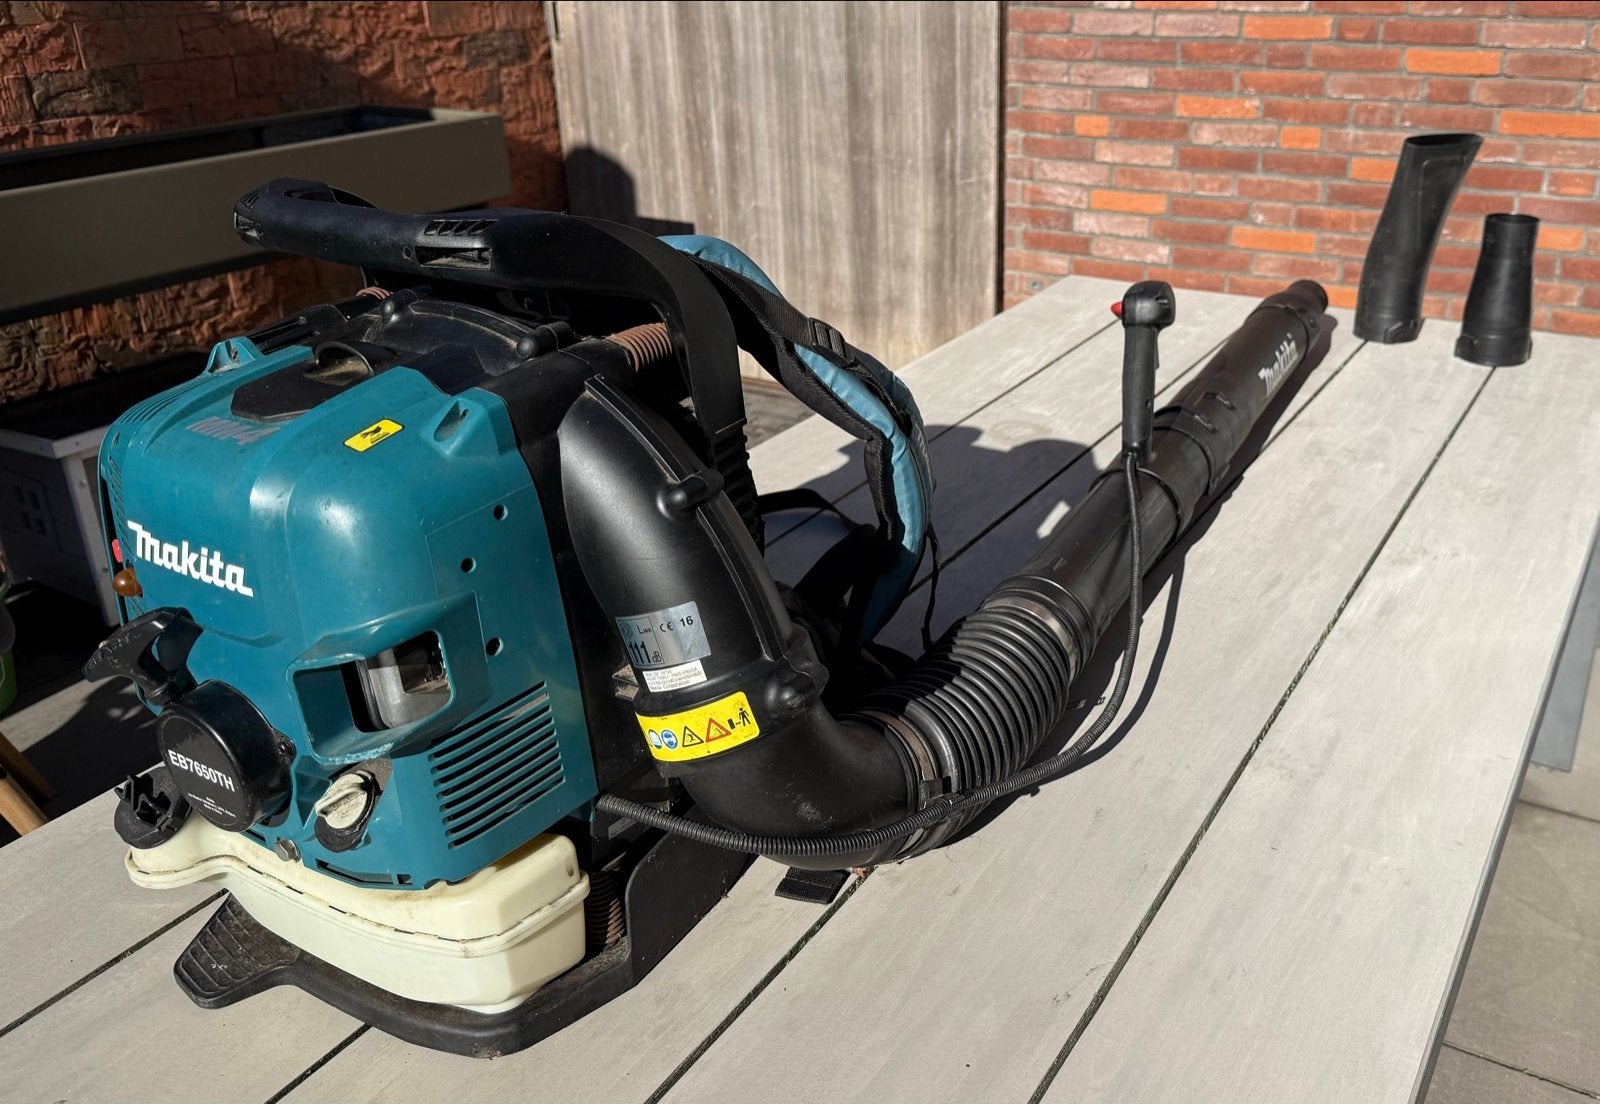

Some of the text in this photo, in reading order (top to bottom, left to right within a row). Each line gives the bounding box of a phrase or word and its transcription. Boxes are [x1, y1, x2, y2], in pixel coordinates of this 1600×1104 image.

[127, 520, 253, 597] Makita
[659, 615, 694, 633] CE 16
[629, 641, 651, 664] 111
[168, 749, 235, 792] EB7650TH
